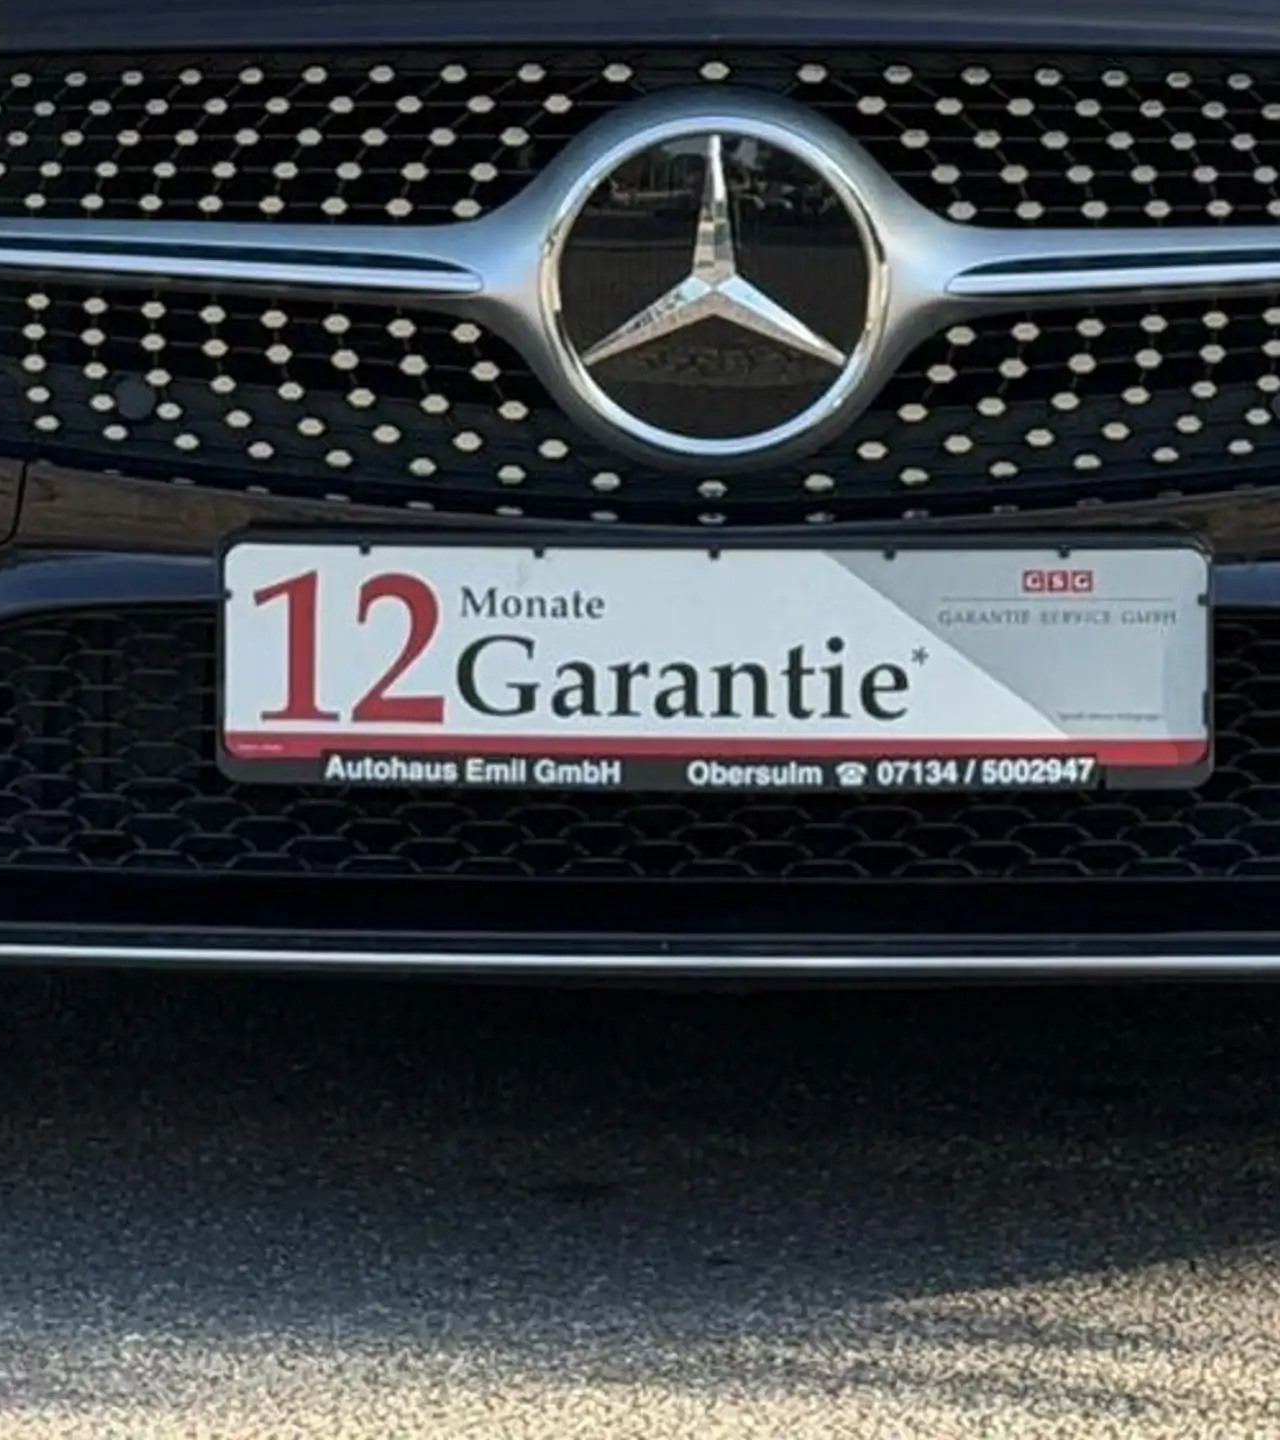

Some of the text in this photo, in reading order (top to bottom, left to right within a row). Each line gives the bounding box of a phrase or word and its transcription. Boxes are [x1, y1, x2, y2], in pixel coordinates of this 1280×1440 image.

[936, 609, 1030, 627] GARANTIE
[252, 570, 606, 725] 12 Monate
[325, 755, 1096, 787] Autohaus Emil GmbH Obersulm 07134 / 5002947
